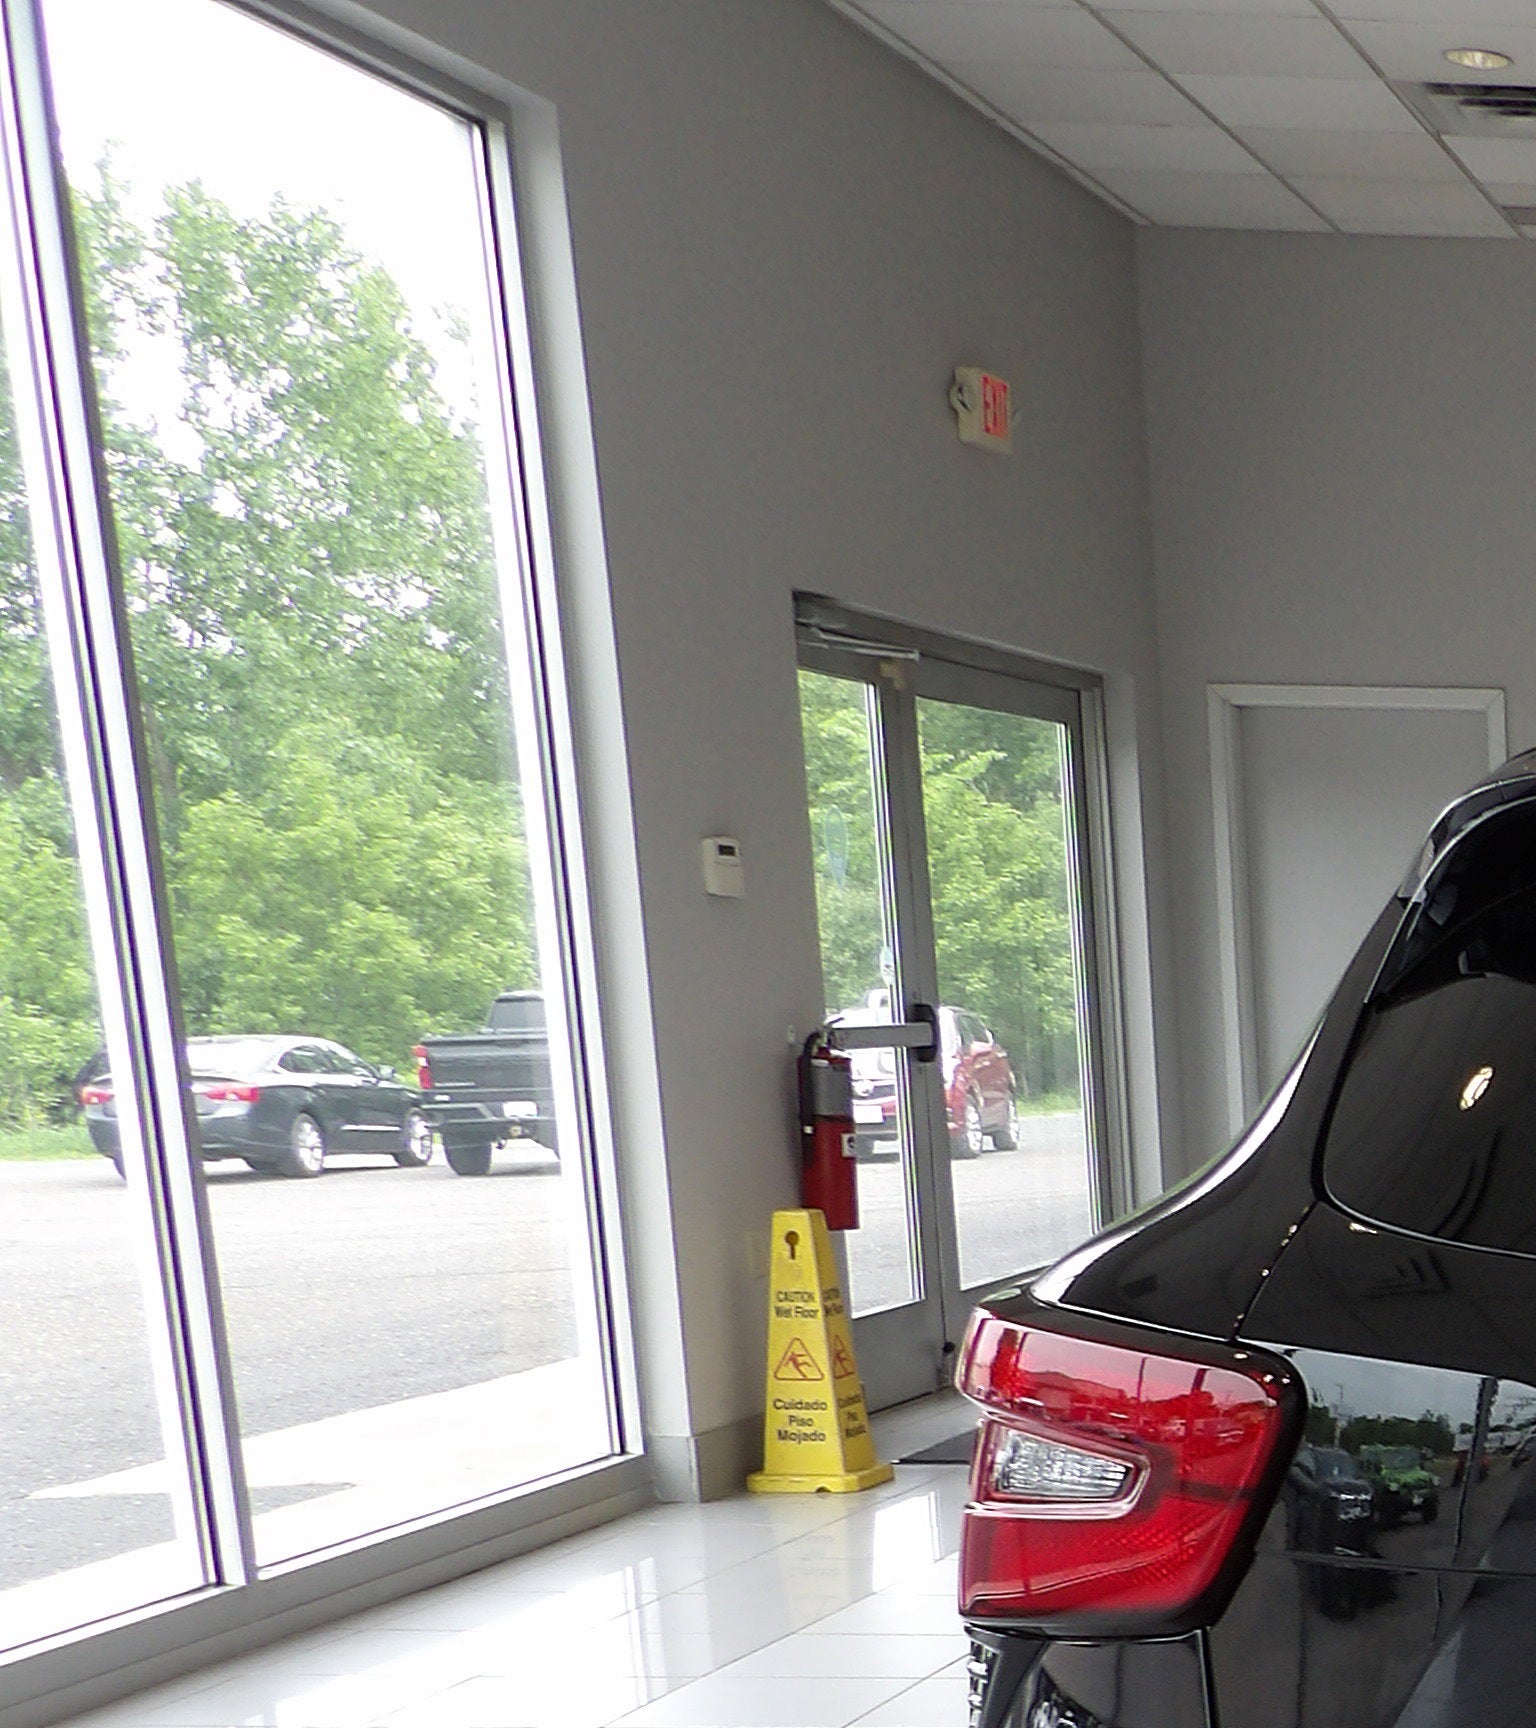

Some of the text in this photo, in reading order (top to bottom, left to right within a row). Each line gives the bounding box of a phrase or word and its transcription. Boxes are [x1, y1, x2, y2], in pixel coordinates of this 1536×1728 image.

[777, 1290, 815, 1303] CAUTION
[774, 1306, 793, 1318] Wet
[795, 1305, 819, 1319] Floor
[773, 1399, 827, 1410] Cuidado
[788, 1415, 814, 1427] Piso
[777, 1429, 826, 1444] Mojado
